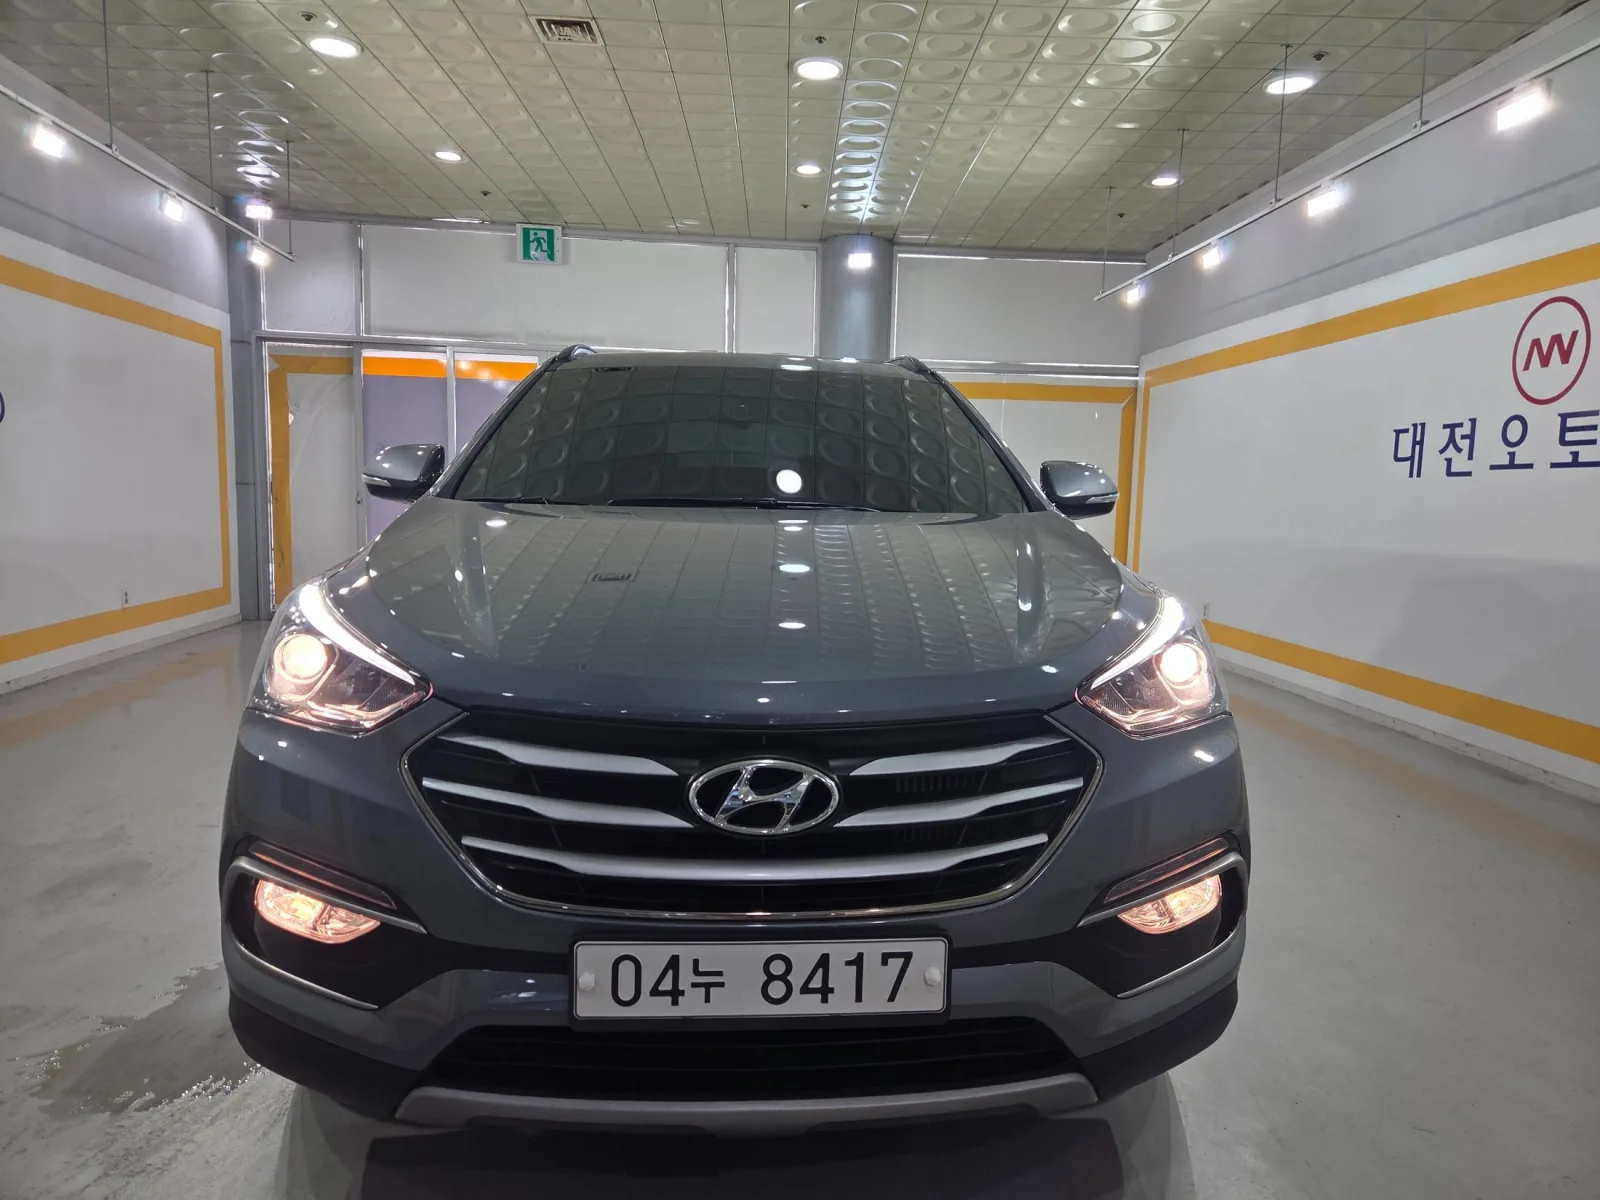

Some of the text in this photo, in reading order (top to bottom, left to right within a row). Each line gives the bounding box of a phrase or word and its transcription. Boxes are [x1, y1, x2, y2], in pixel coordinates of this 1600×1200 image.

[1393, 410, 1600, 478] 대전오토
[611, 951, 913, 1007] 04누 8417
